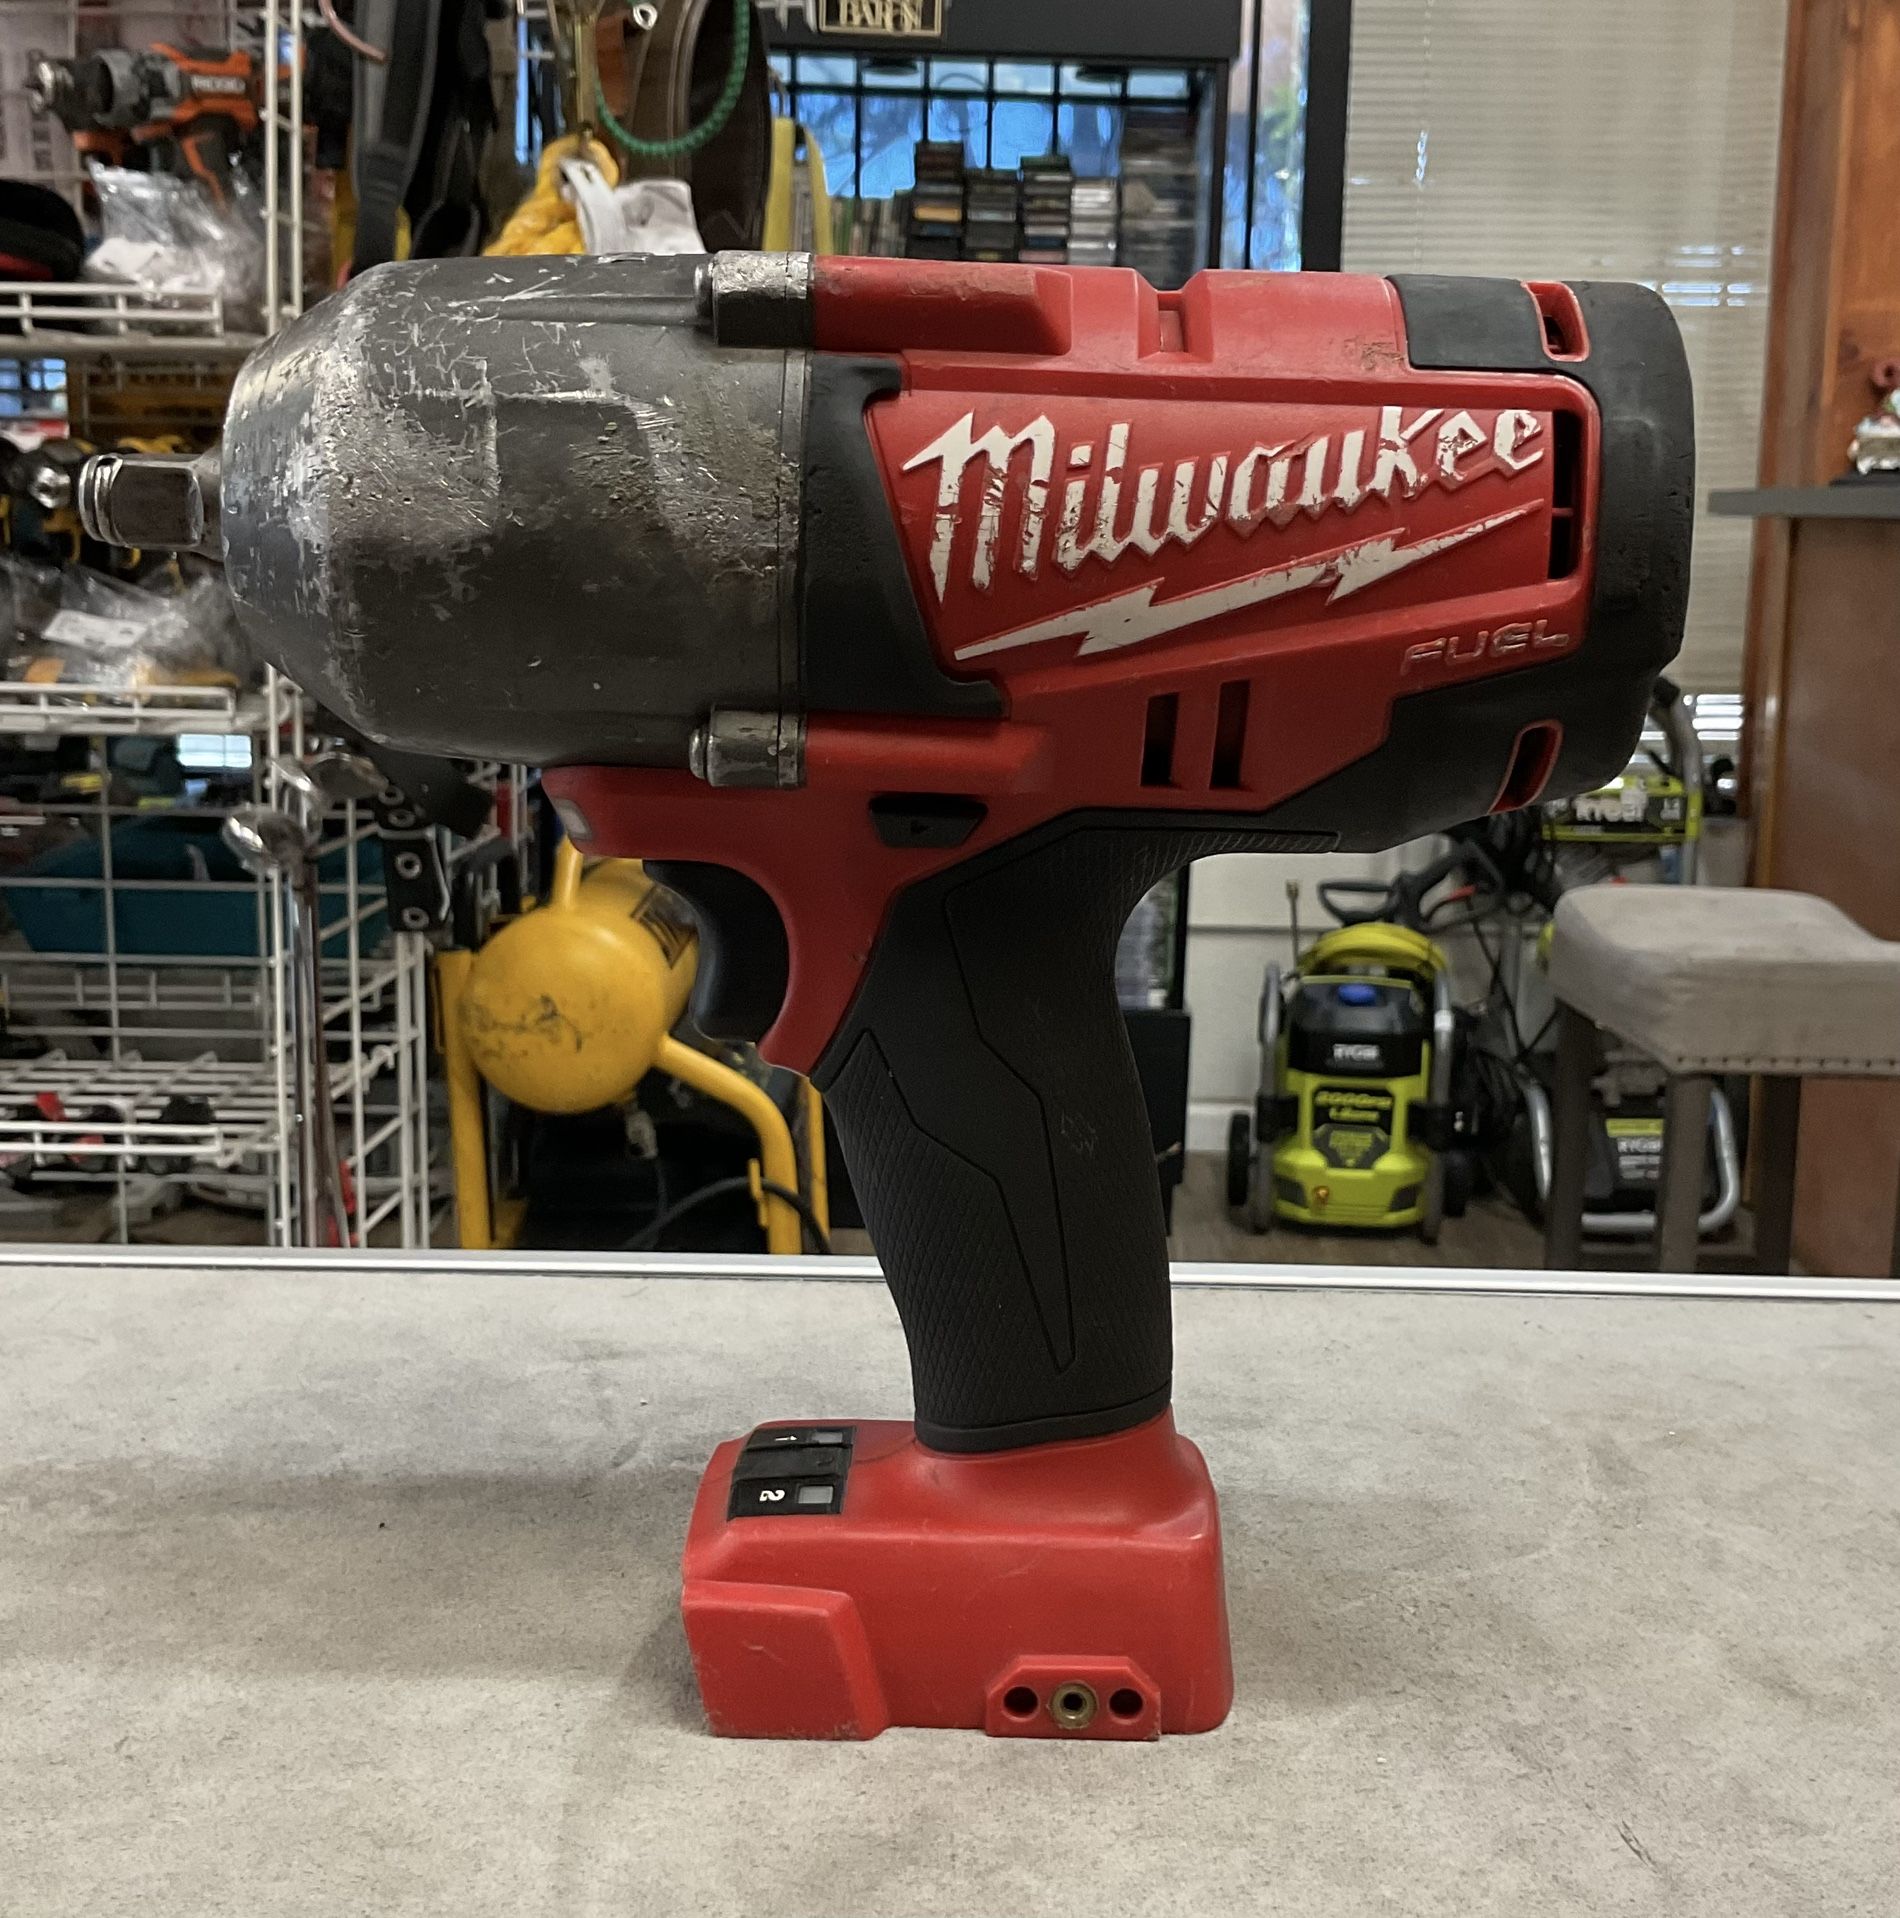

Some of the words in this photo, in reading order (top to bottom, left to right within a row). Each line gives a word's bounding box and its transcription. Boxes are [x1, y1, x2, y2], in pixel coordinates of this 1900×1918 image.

[903, 405, 1547, 604] Milwaukee
[1401, 619, 1570, 677] FUEL
[759, 1489, 786, 1502] 2
